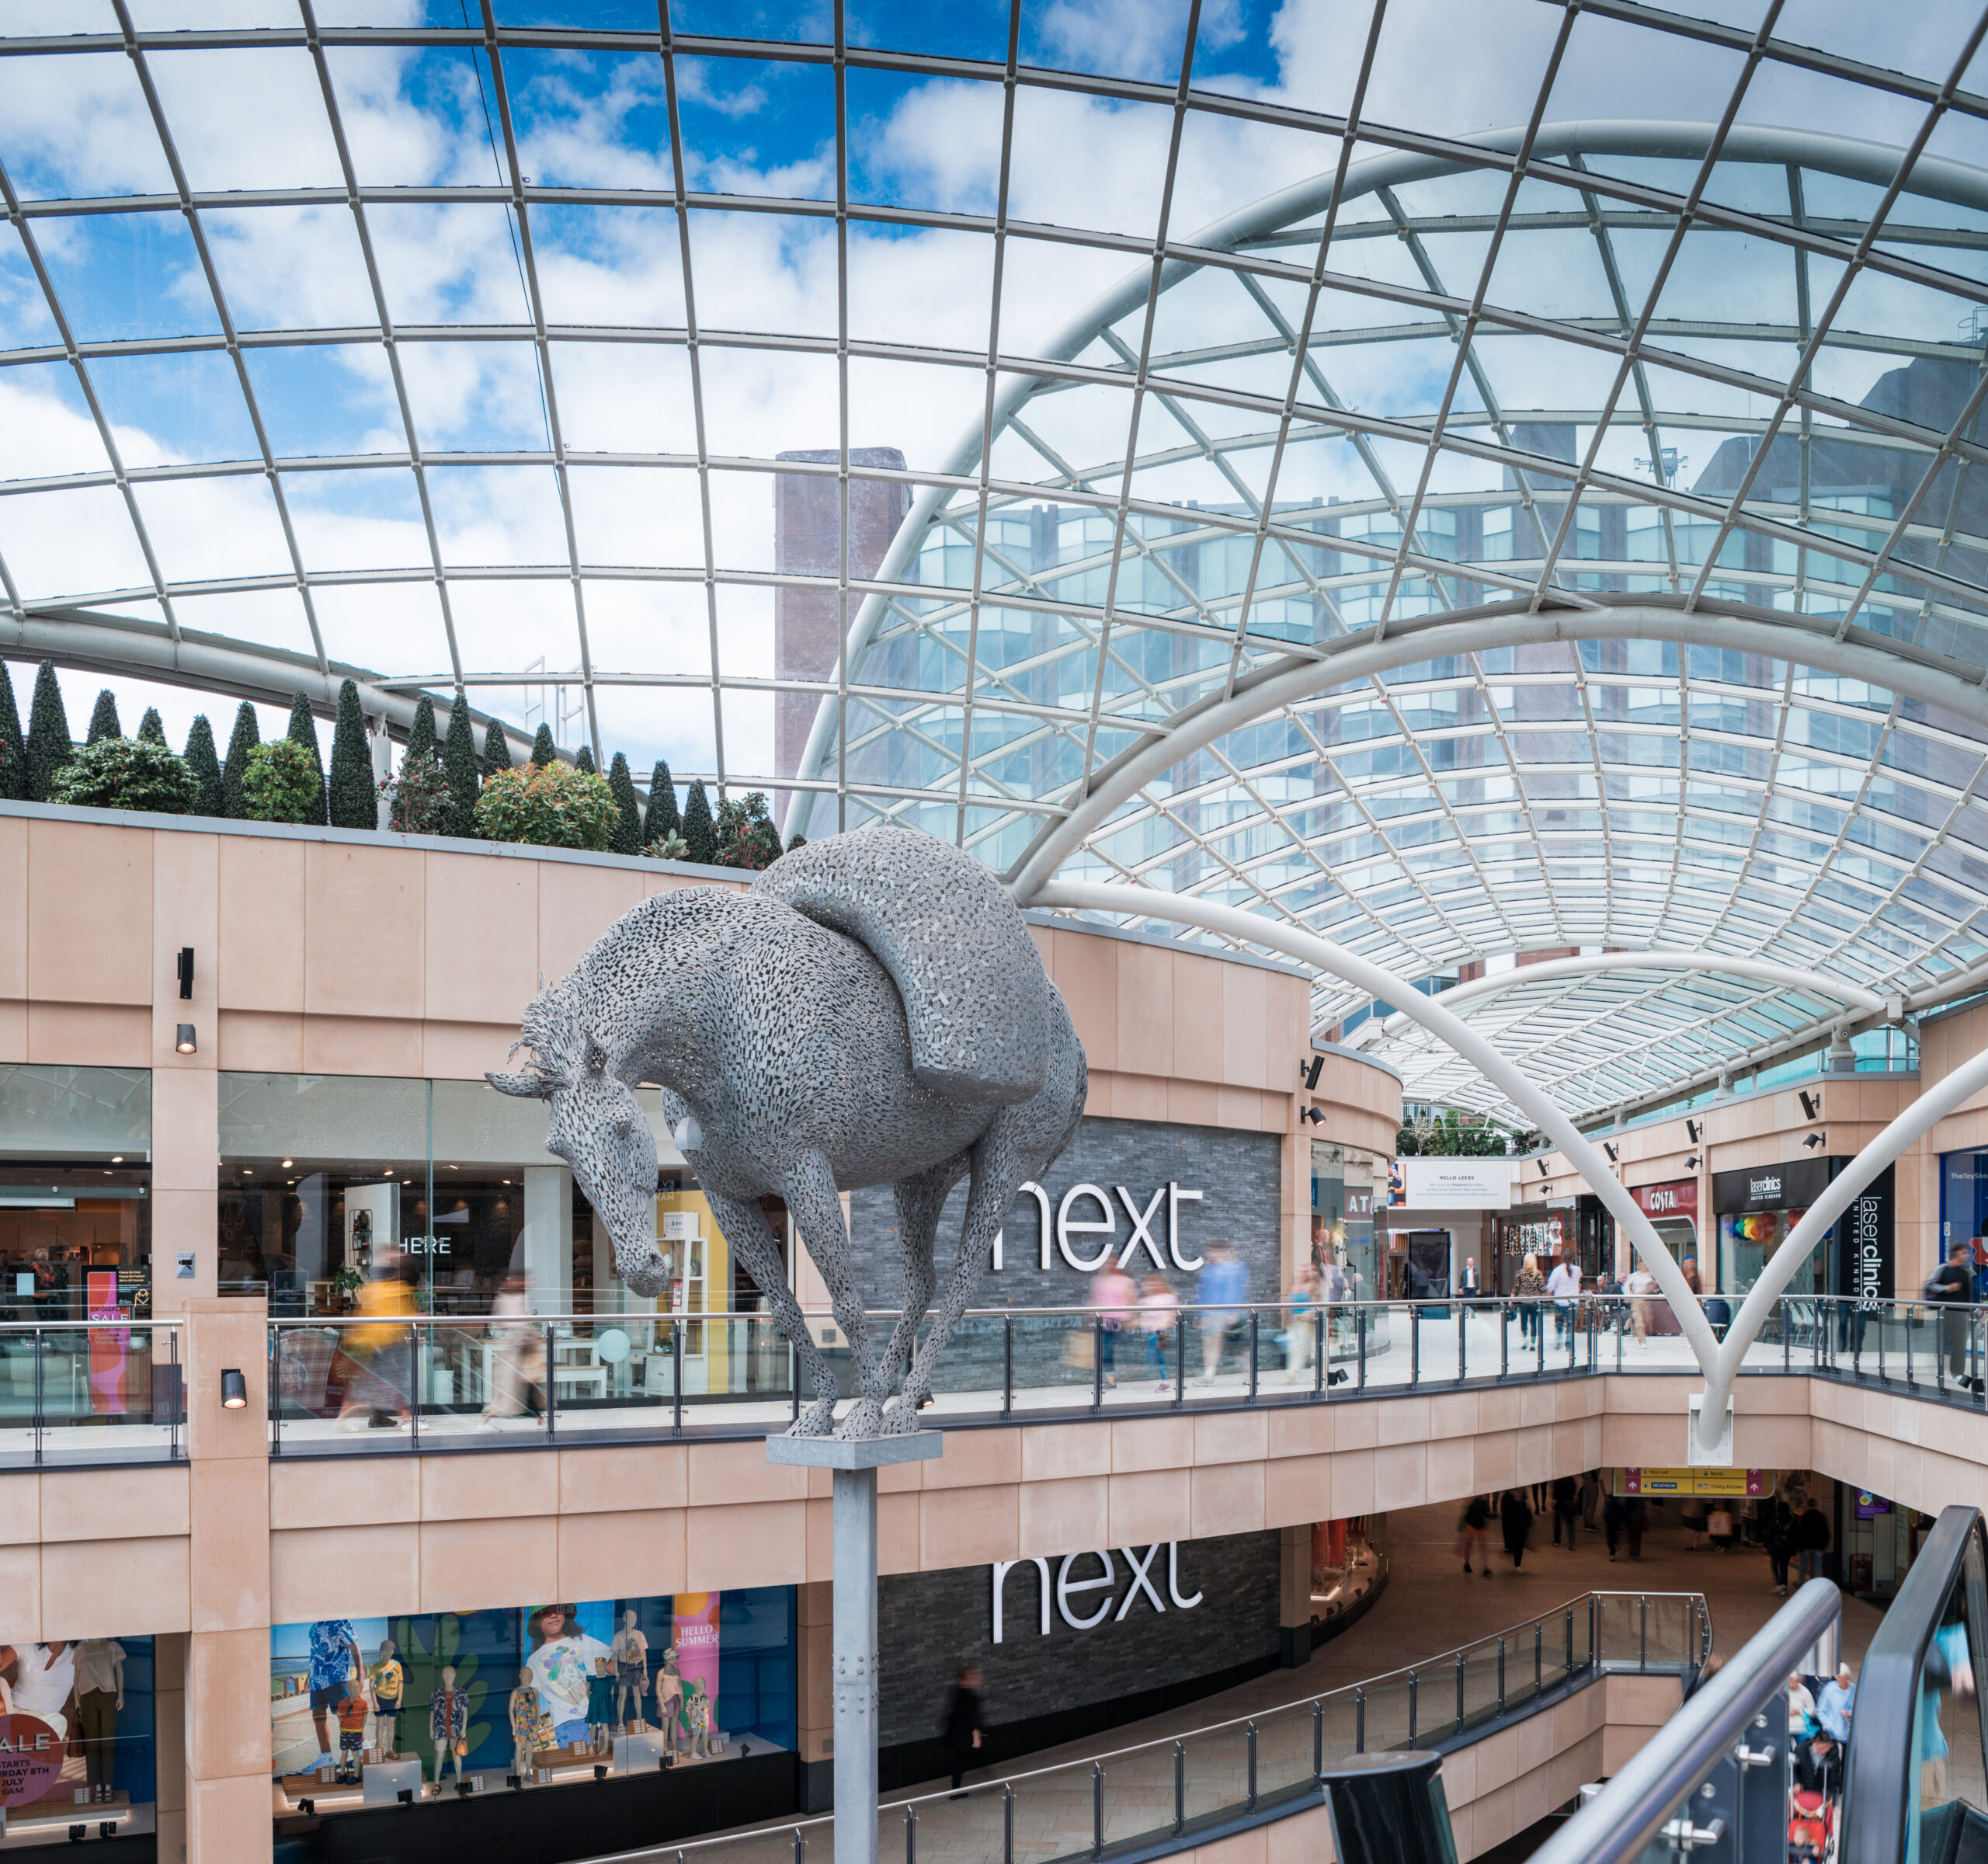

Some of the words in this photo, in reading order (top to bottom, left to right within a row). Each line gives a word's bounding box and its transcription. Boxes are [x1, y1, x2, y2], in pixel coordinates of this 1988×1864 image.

[1650, 1191, 1676, 1212] COSTA
[992, 1181, 1204, 1271] next
[681, 1624, 713, 1636] HELLO
[676, 1634, 718, 1647] SUMMER
[30, 1767, 49, 1775] 8TH
[2, 1778, 24, 1786] JULY
[2, 1787, 24, 1796] 6AM
